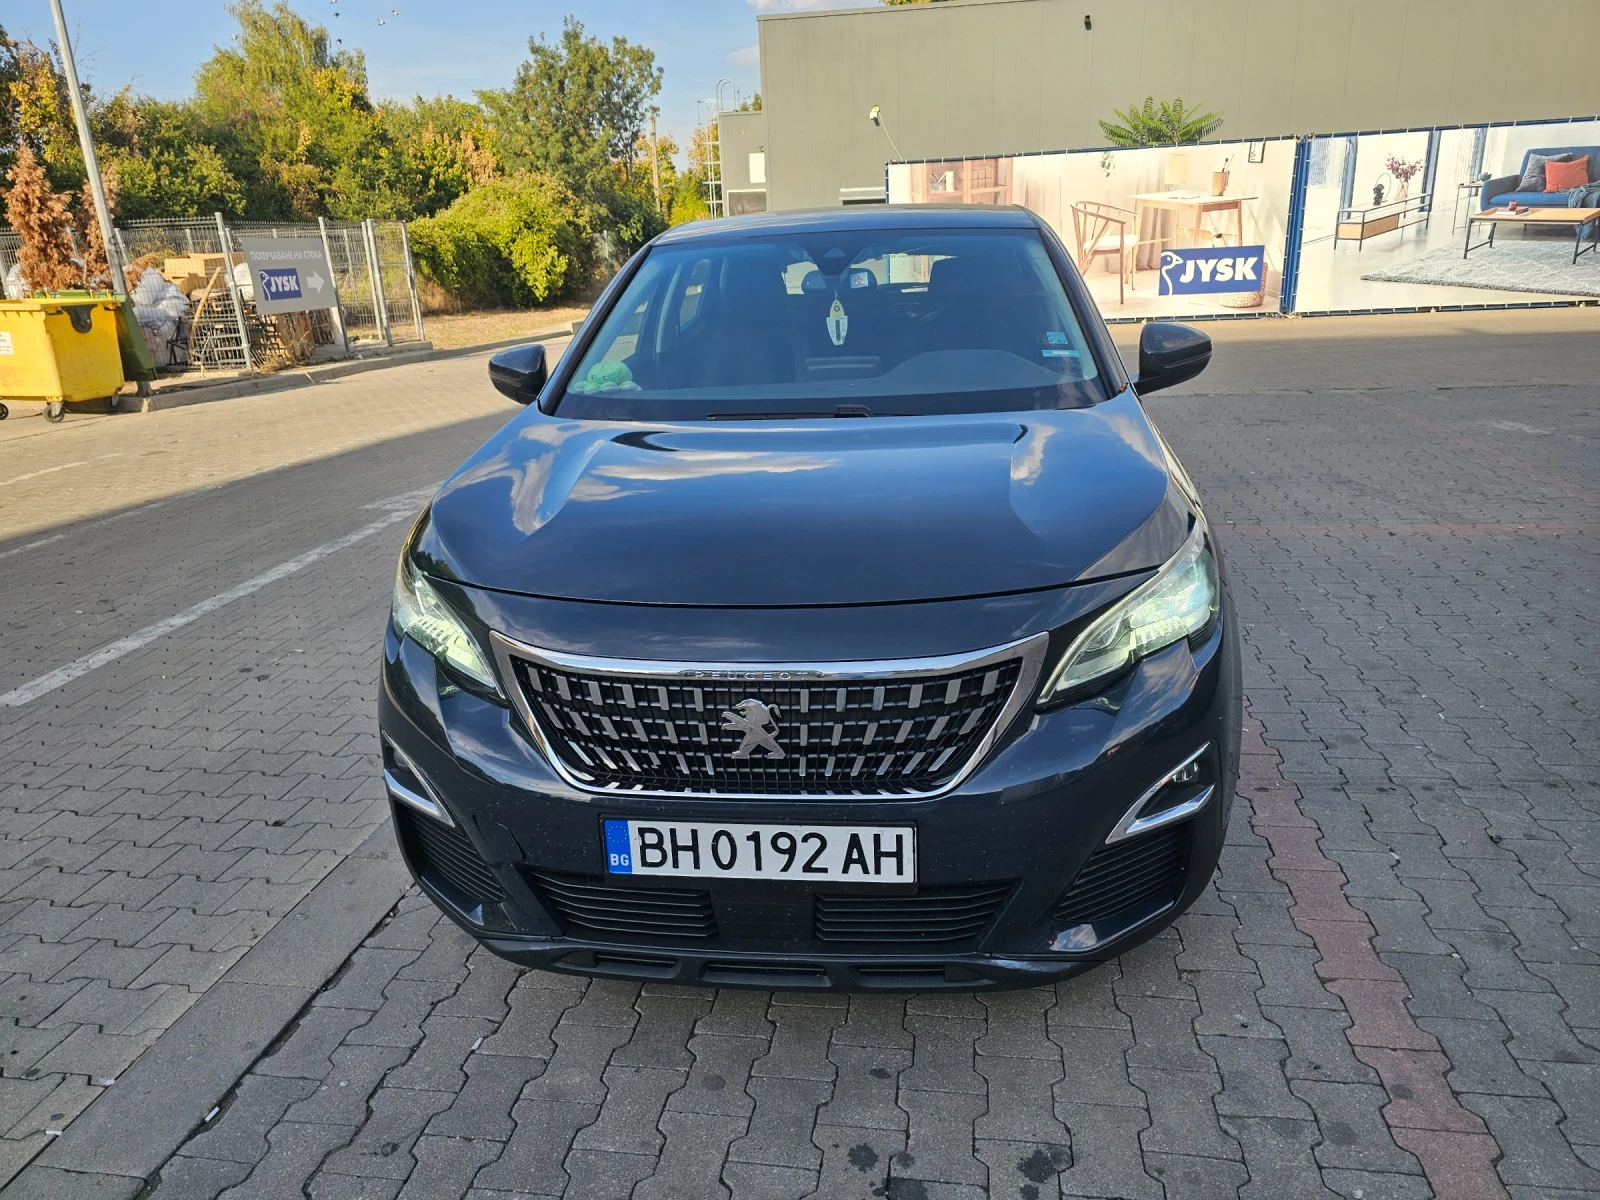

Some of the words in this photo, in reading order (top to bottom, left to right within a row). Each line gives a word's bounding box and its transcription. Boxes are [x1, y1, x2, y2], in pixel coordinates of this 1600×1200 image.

[250, 251, 293, 260] ПОЛУЧАВАНЕ
[294, 251, 304, 260] НА
[303, 250, 323, 260] СТОКА
[1179, 257, 1259, 284] JYSK
[270, 275, 299, 293] JYSK
[694, 671, 808, 680] PEUGEOT
[637, 826, 700, 870] BH
[711, 829, 829, 873] 0192
[841, 832, 904, 876] AH
[610, 853, 630, 867] BG
